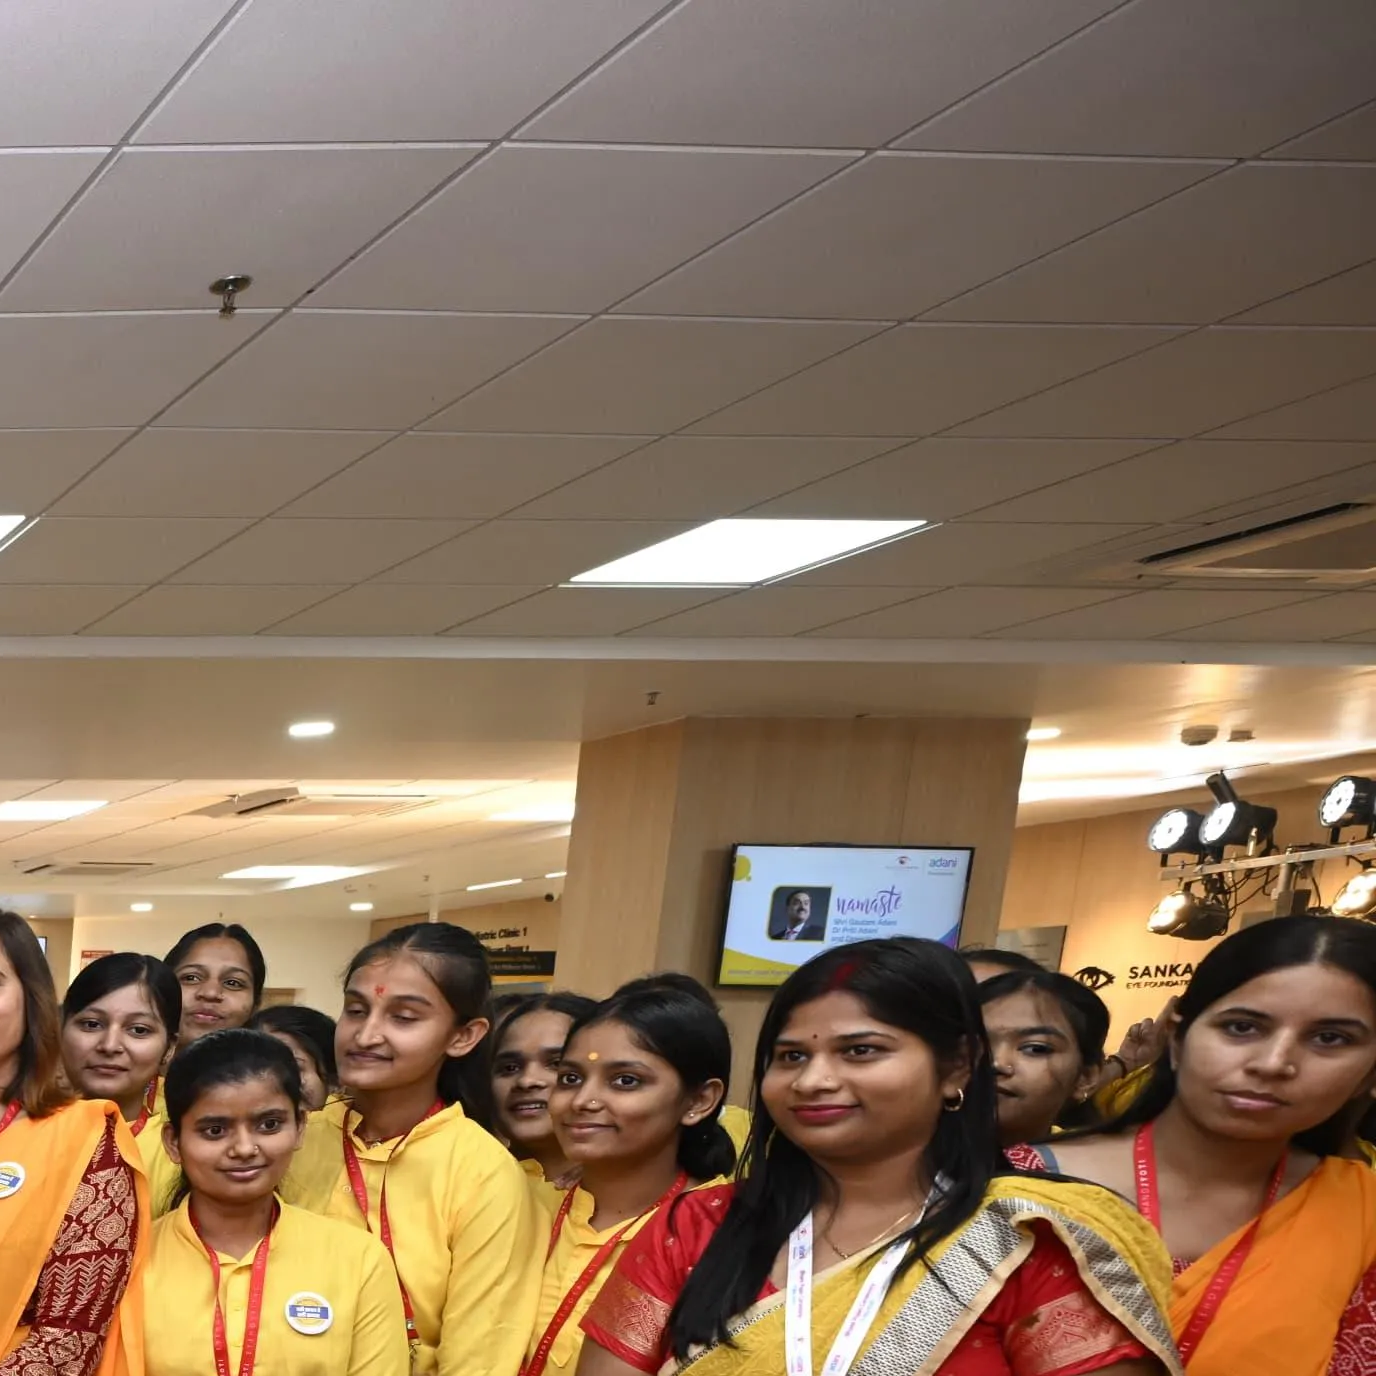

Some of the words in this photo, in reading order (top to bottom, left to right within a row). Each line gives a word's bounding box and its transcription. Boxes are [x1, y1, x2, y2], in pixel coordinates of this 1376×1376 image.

[929, 857, 958, 869] adani
[836, 885, 903, 917] namaste
[1126, 981, 1144, 989] EYE
